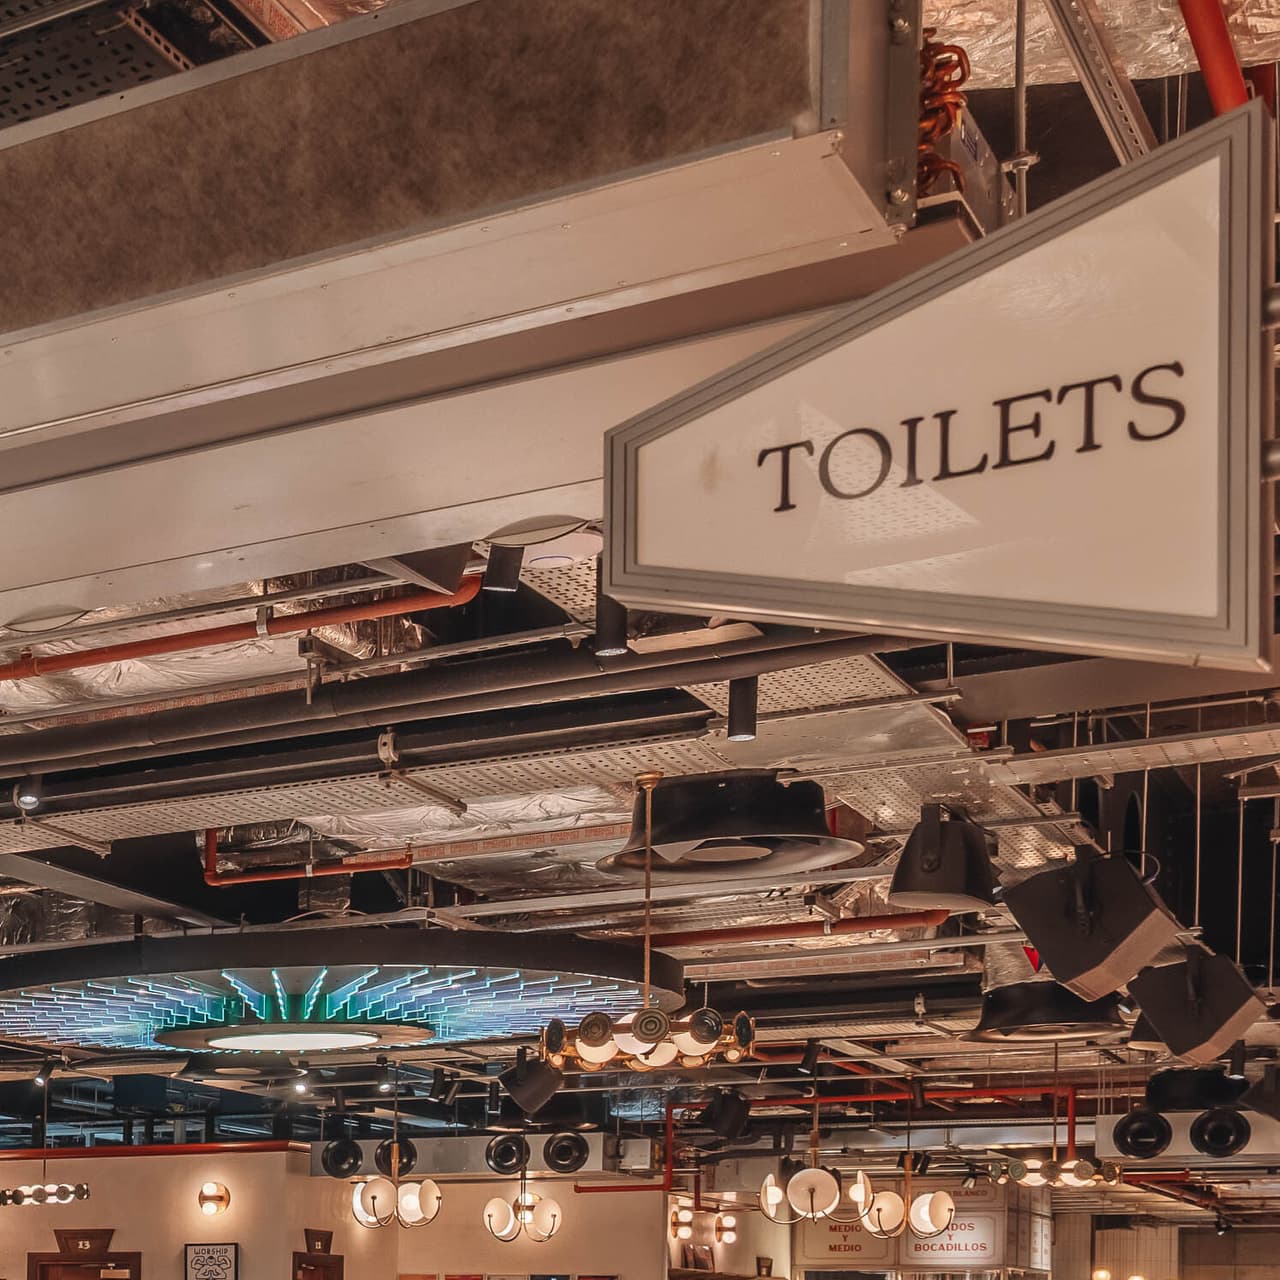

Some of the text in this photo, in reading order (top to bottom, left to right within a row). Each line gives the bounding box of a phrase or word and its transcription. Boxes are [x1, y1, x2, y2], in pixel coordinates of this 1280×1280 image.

[757, 361, 1186, 513] TOILETS
[829, 1225, 862, 1233] MEDIO
[842, 1234, 849, 1242] Y
[947, 1233, 954, 1241] Y
[77, 1240, 91, 1250] 13
[829, 1244, 862, 1252] MEDIO
[914, 1243, 987, 1252] BOCADILLOS
